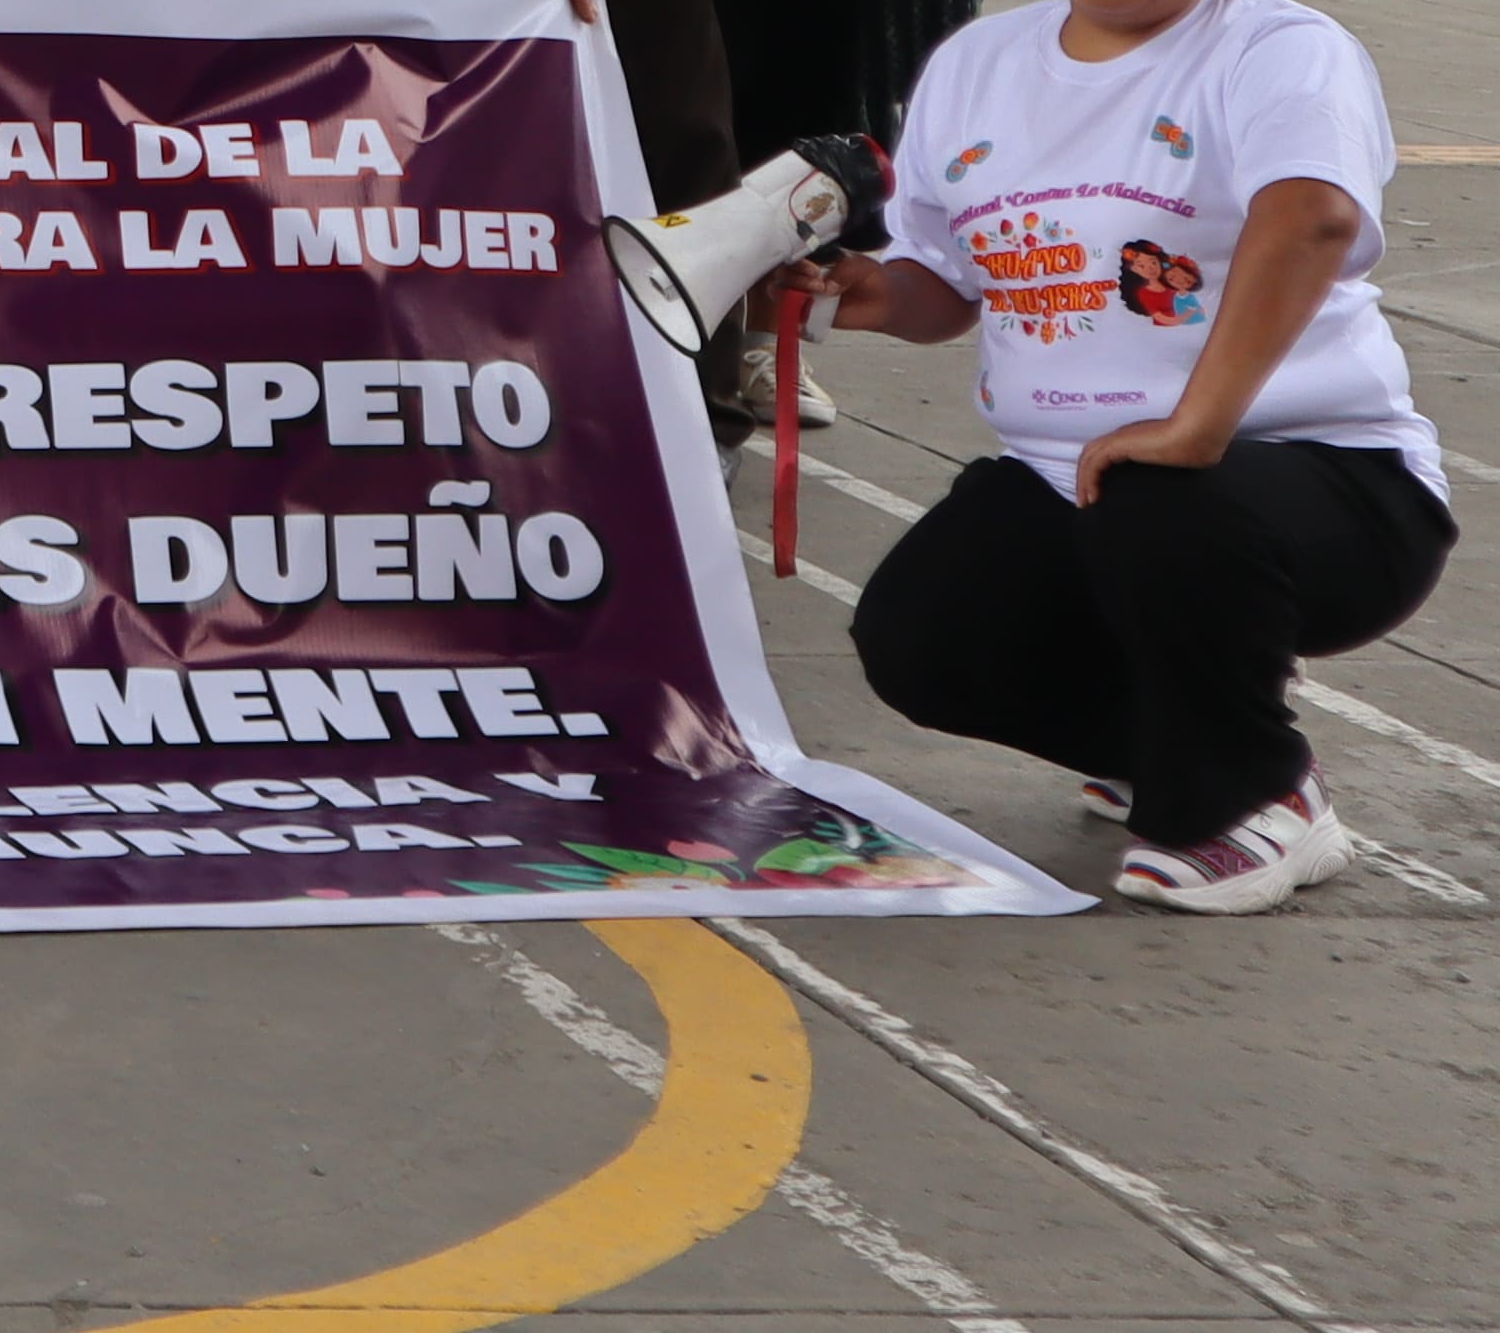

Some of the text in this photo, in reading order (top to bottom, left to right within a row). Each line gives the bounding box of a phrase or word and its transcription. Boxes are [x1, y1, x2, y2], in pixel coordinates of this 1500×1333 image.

[132, 122, 260, 179] DE
[281, 119, 403, 179] LA
[119, 209, 246, 270] LA
[271, 205, 559, 273] MUJER
[128, 480, 605, 603] DUEÑO
[53, 665, 609, 747] MENTE.
[494, 771, 600, 803] Y
